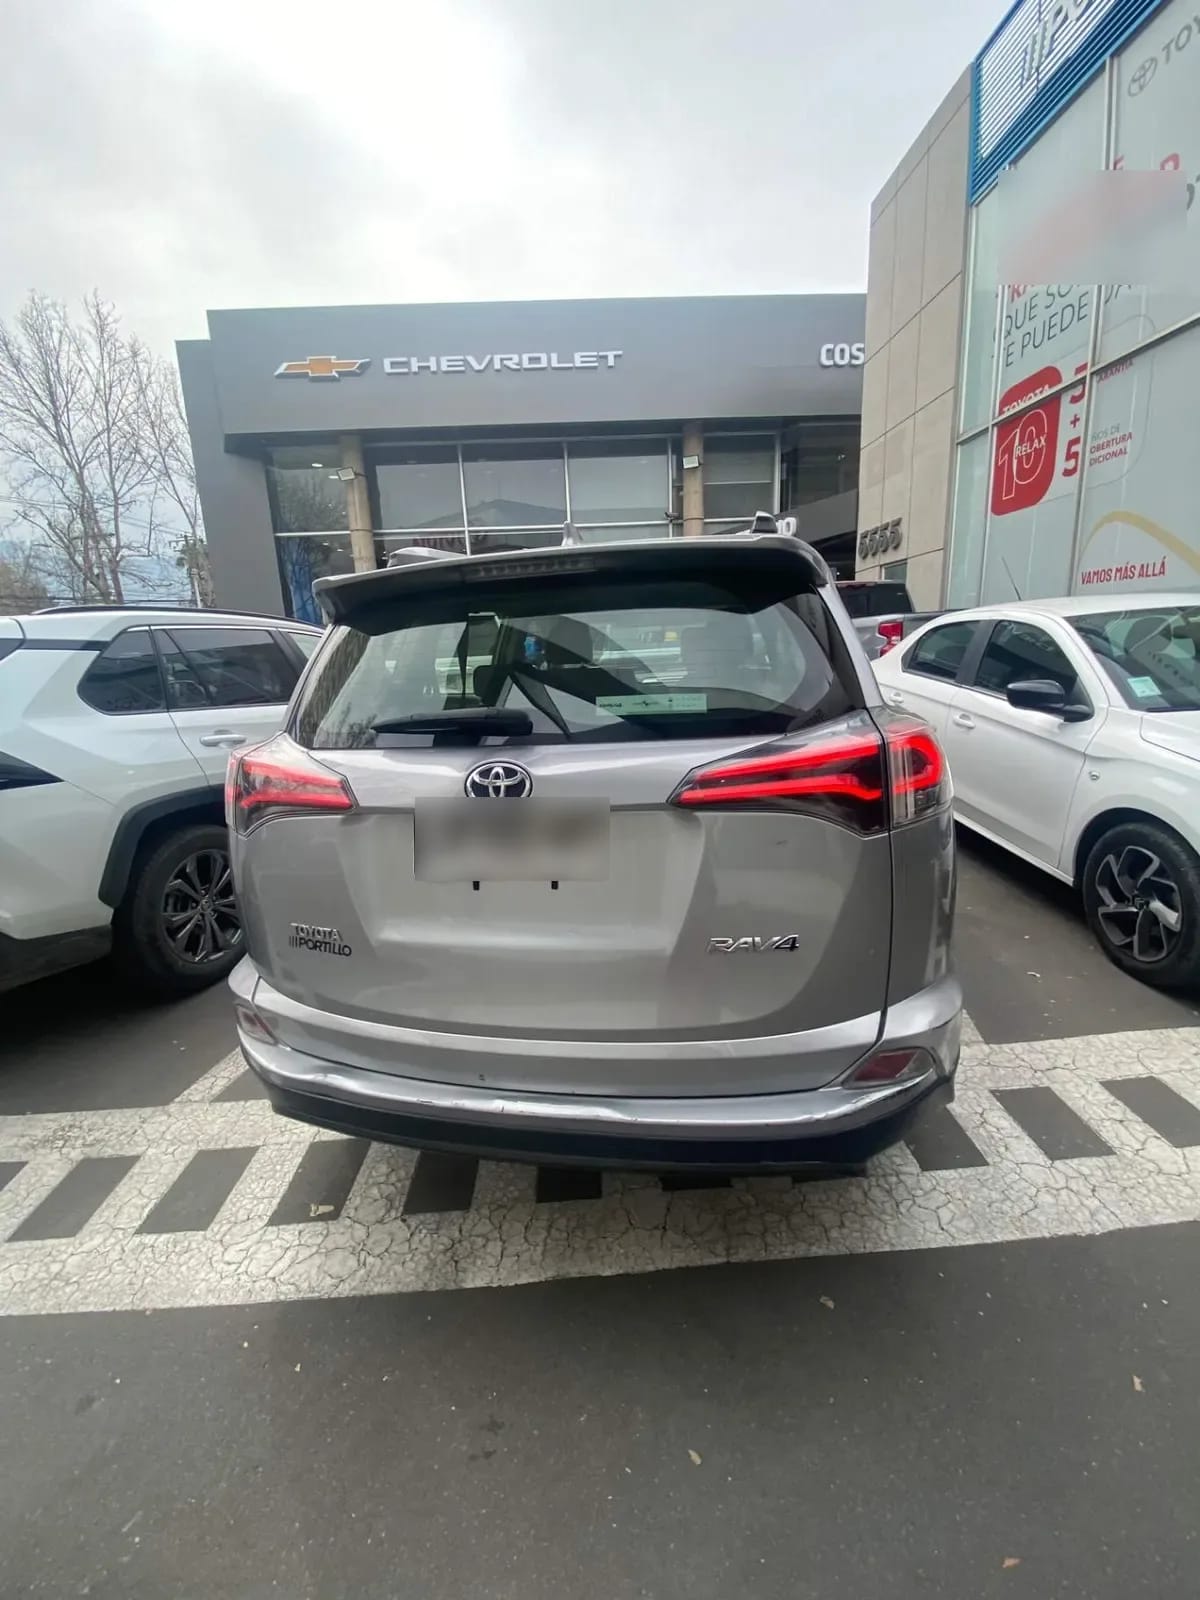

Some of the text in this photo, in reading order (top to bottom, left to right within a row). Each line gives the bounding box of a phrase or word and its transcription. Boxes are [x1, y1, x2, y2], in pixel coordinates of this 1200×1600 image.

[1162, 14, 1200, 64] TO
[1020, 290, 1089, 358] PUEDE
[383, 350, 623, 375] CHEVROLET
[820, 342, 865, 367] COS
[999, 409, 1047, 500] 10
[1015, 434, 1047, 459] RELAX
[1089, 431, 1133, 454] OBERTURA
[1062, 436, 1081, 477] 5
[1088, 446, 1128, 467] DICIONAL
[1081, 556, 1166, 585] VAMOS MÁS ALLÁ
[290, 922, 343, 942] TOYOTA
[706, 934, 800, 953] RAV4
[299, 937, 352, 957] PORTILLO
